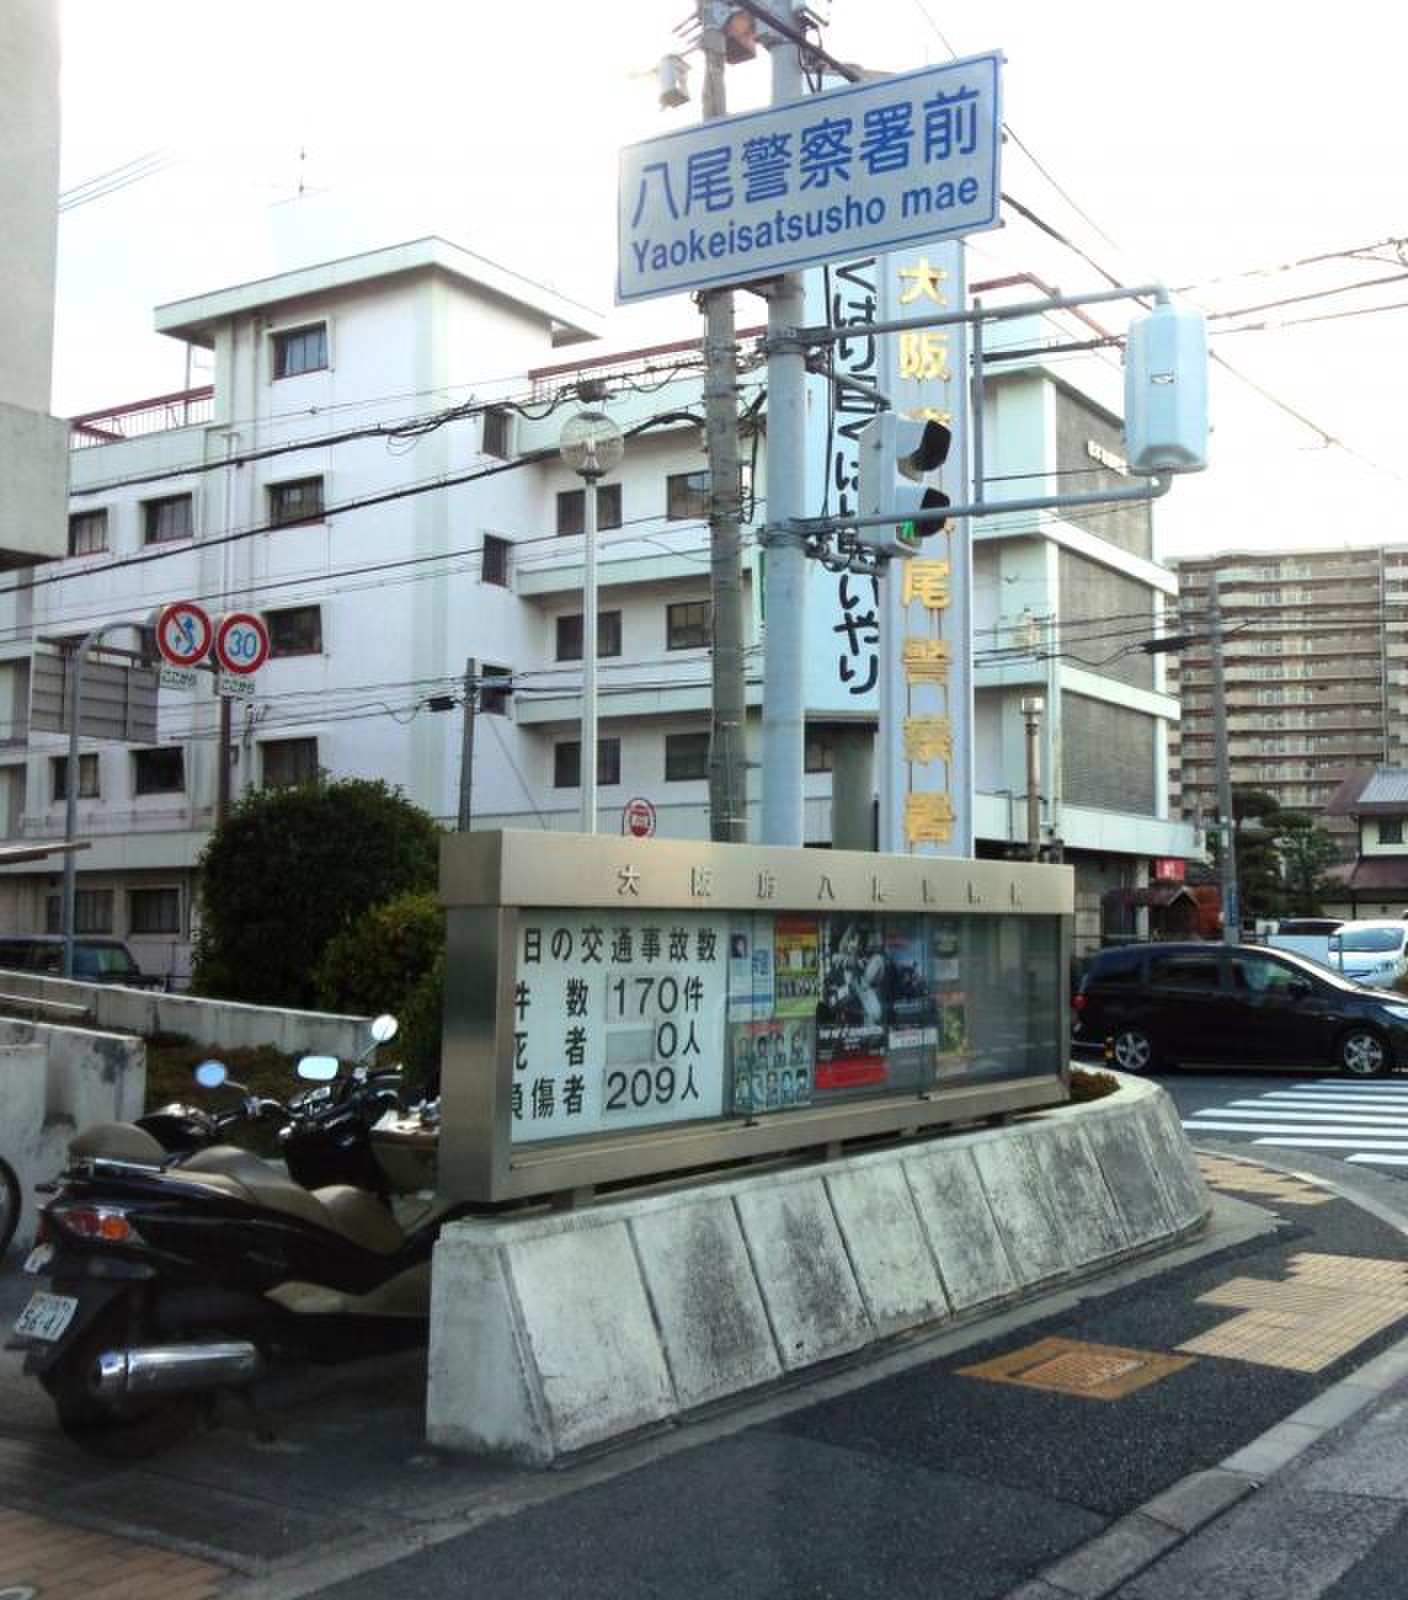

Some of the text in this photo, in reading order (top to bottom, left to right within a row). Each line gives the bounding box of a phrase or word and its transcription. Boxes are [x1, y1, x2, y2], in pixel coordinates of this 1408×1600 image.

[631, 85, 981, 229] 八尾警察署前
[632, 176, 979, 274] Yaokeisatsusho mae
[897, 256, 953, 846] 大阪尾警察署
[229, 628, 257, 659] 30
